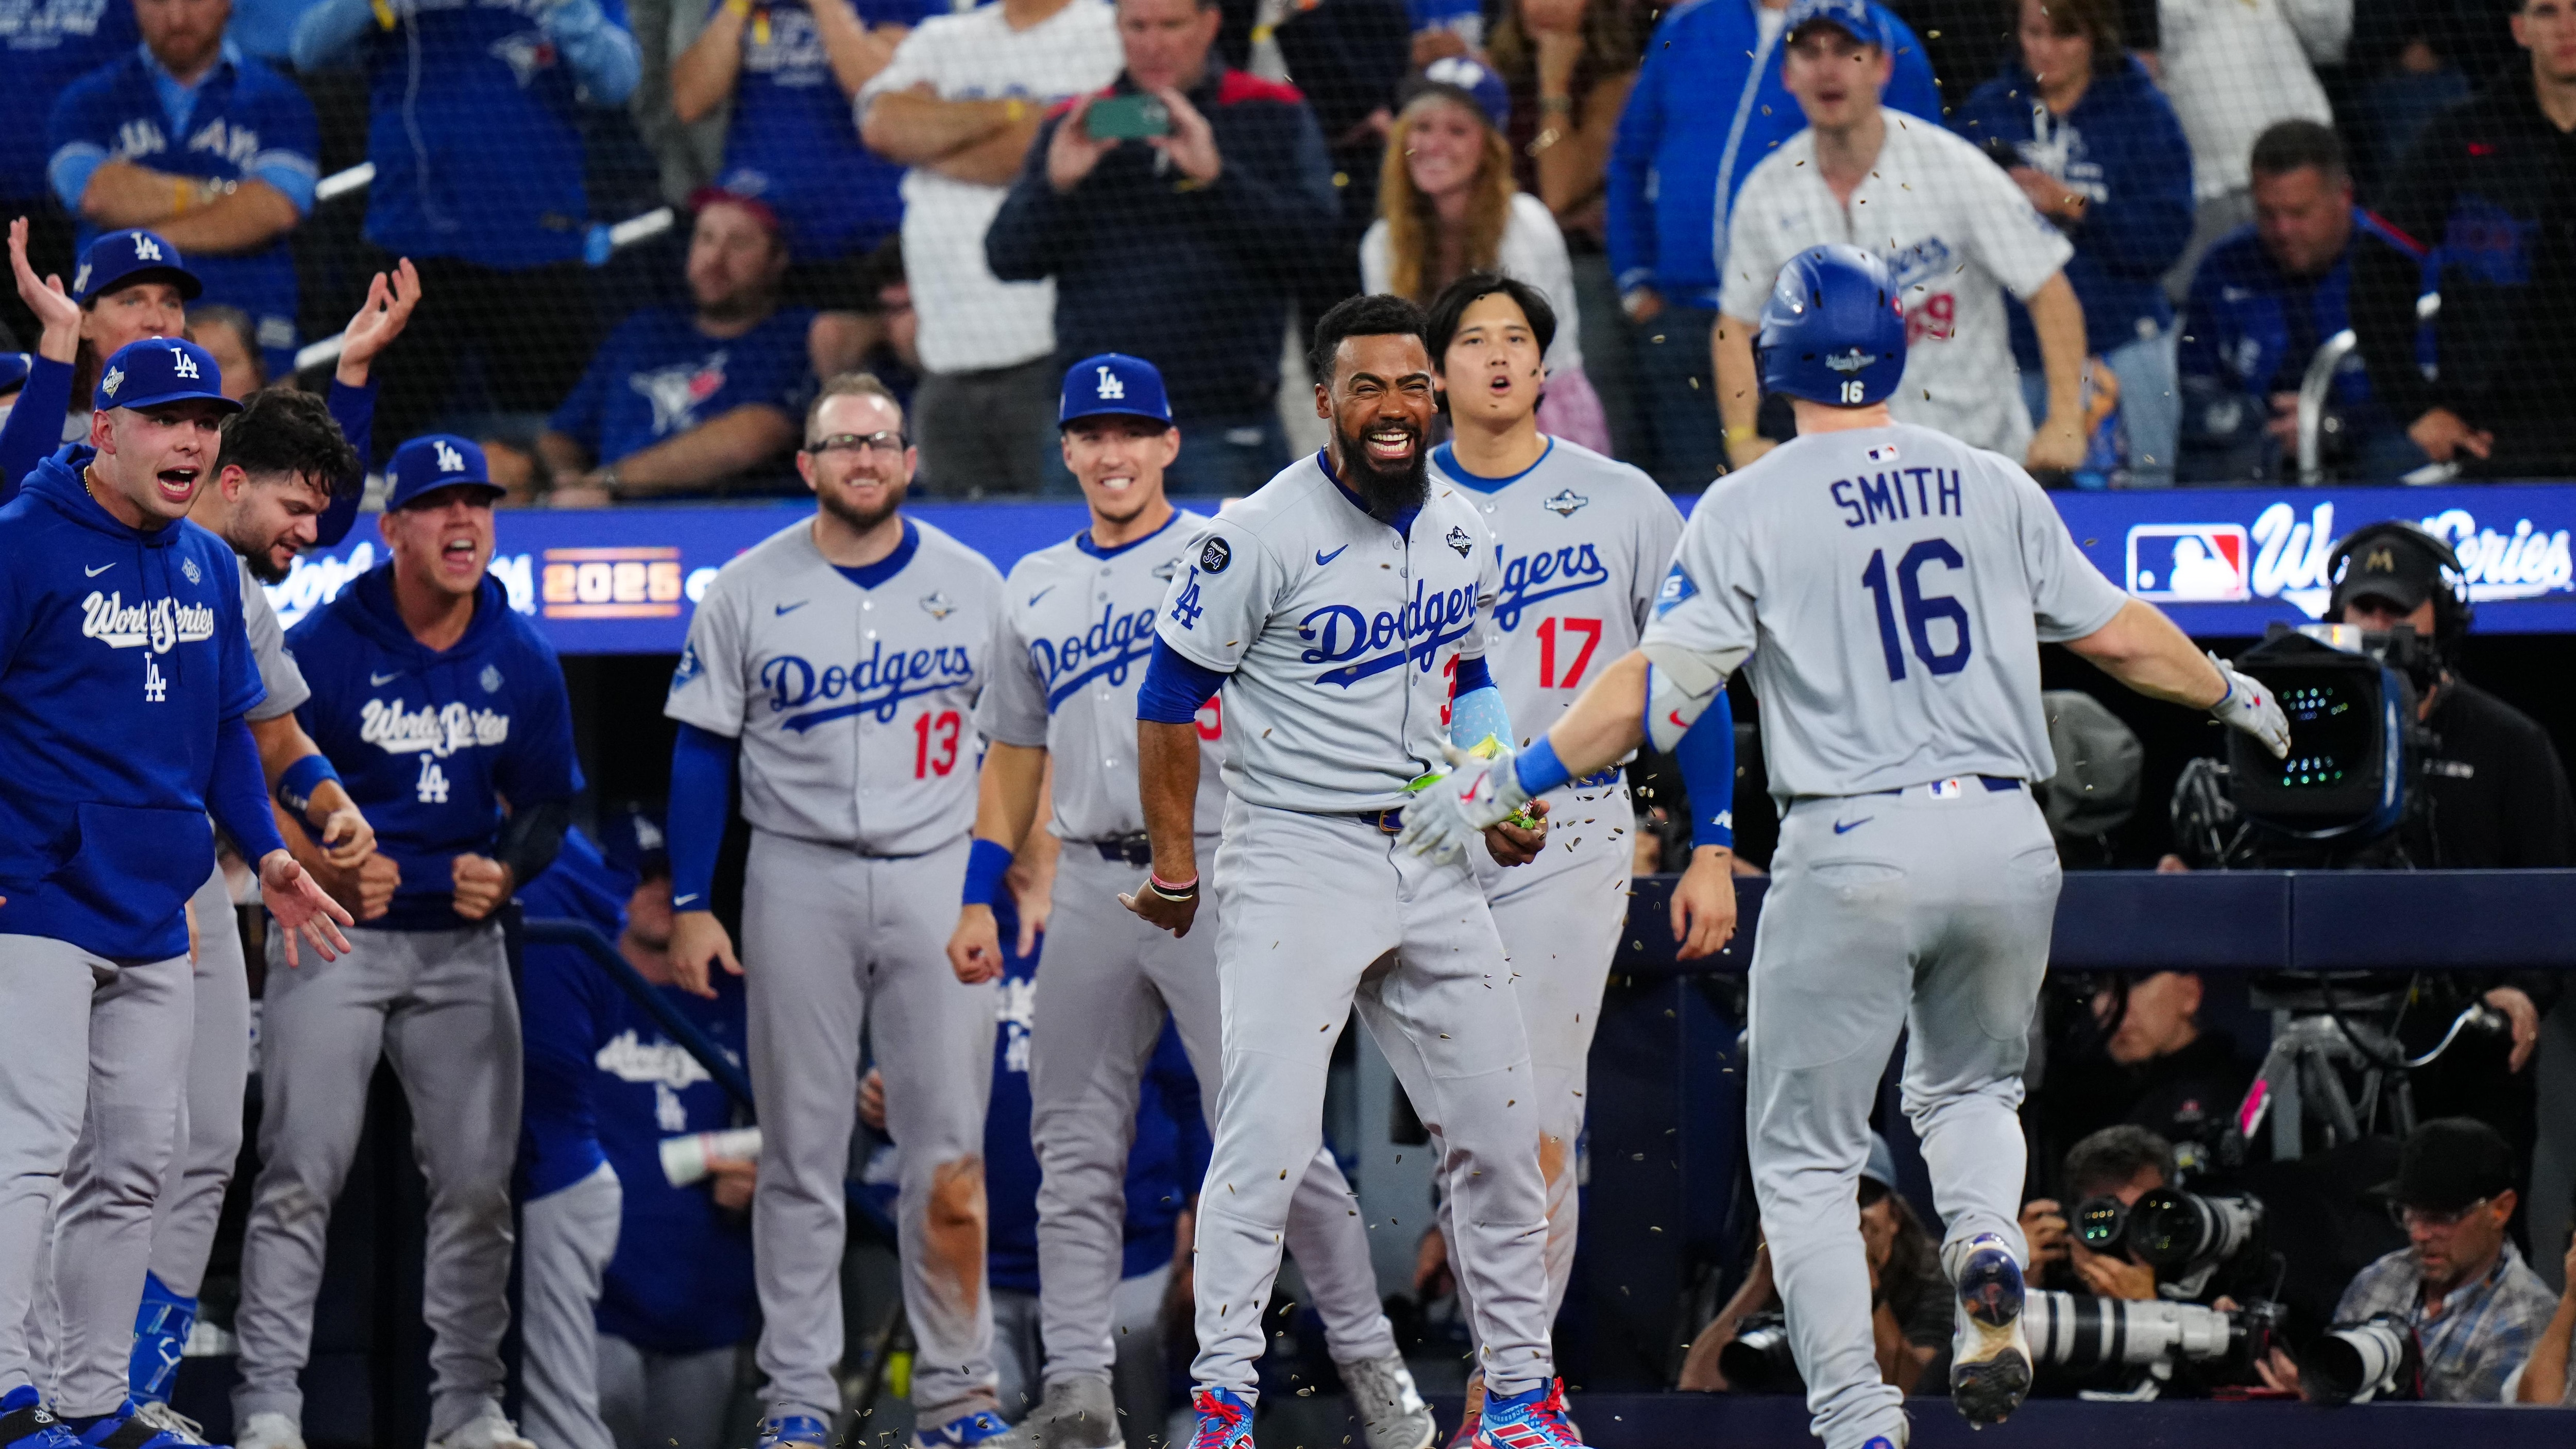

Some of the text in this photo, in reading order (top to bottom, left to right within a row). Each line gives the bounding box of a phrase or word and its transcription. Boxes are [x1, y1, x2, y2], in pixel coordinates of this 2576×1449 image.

[130, 232, 162, 261] LA
[171, 347, 199, 379] LA
[1096, 366, 1125, 399] LA
[1840, 380, 1865, 403] 16
[433, 440, 465, 472] LA
[1829, 467, 1962, 528] SMITH
[1203, 547, 1224, 570] 34
[1210, 540, 1228, 556] FERNANDO
[543, 561, 681, 603] 2025
[1171, 565, 1204, 630] LA
[1492, 542, 1608, 633] gers
[81, 590, 214, 654] World Series
[1298, 578, 1479, 673] Dodger
[1861, 538, 1973, 683] 16
[1029, 602, 1157, 693] Dodge
[1536, 616, 1603, 689] 17
[144, 652, 166, 702] LA
[760, 640, 974, 723] Dodgers
[914, 710, 962, 780] 13
[416, 753, 450, 803] LA
